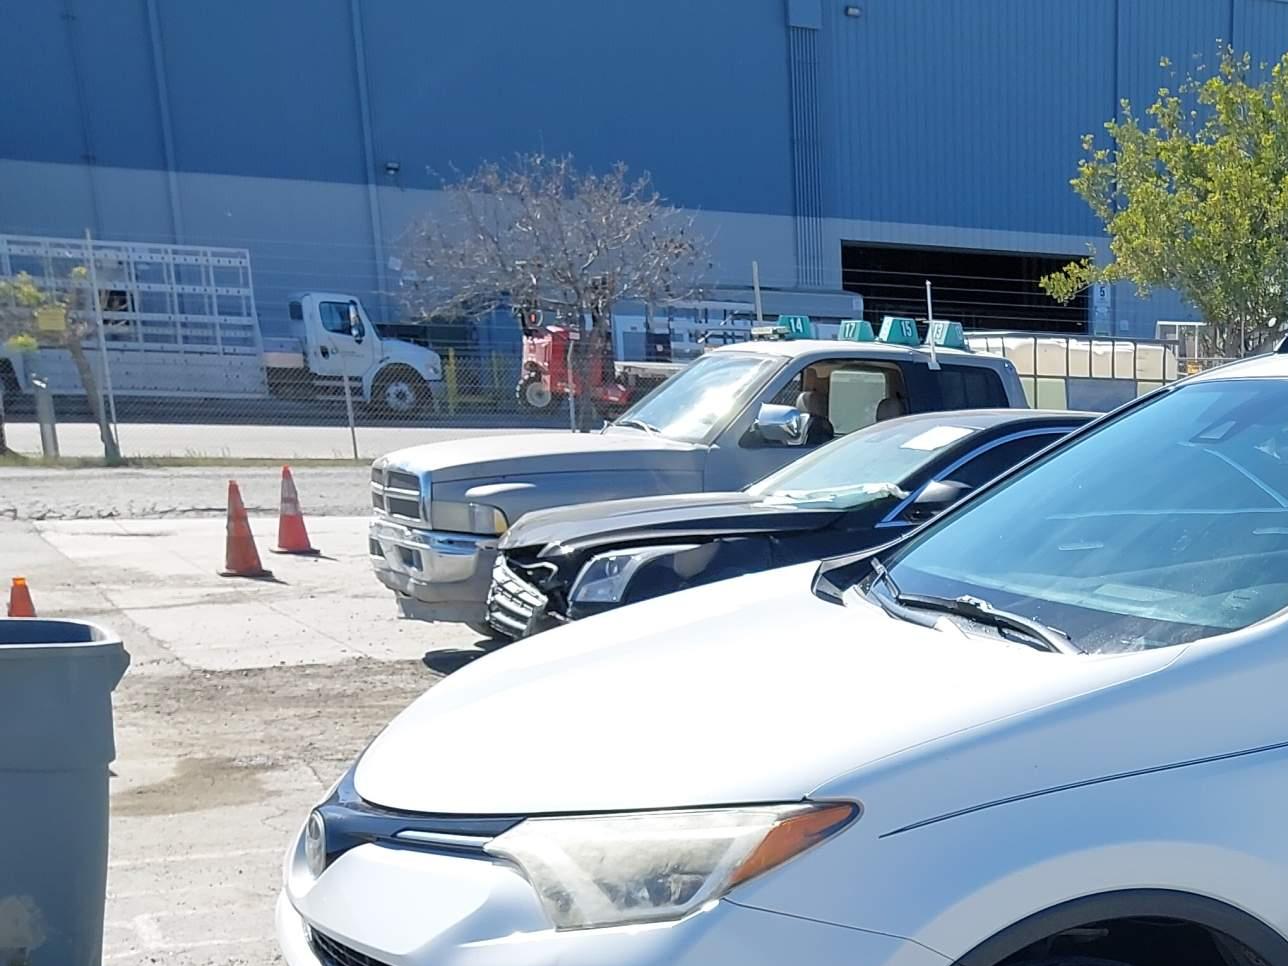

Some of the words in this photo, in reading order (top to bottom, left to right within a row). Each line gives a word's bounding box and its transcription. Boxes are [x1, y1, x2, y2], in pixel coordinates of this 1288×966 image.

[1099, 286, 1106, 297] 5
[789, 317, 804, 333] 14
[900, 320, 913, 337] 15
